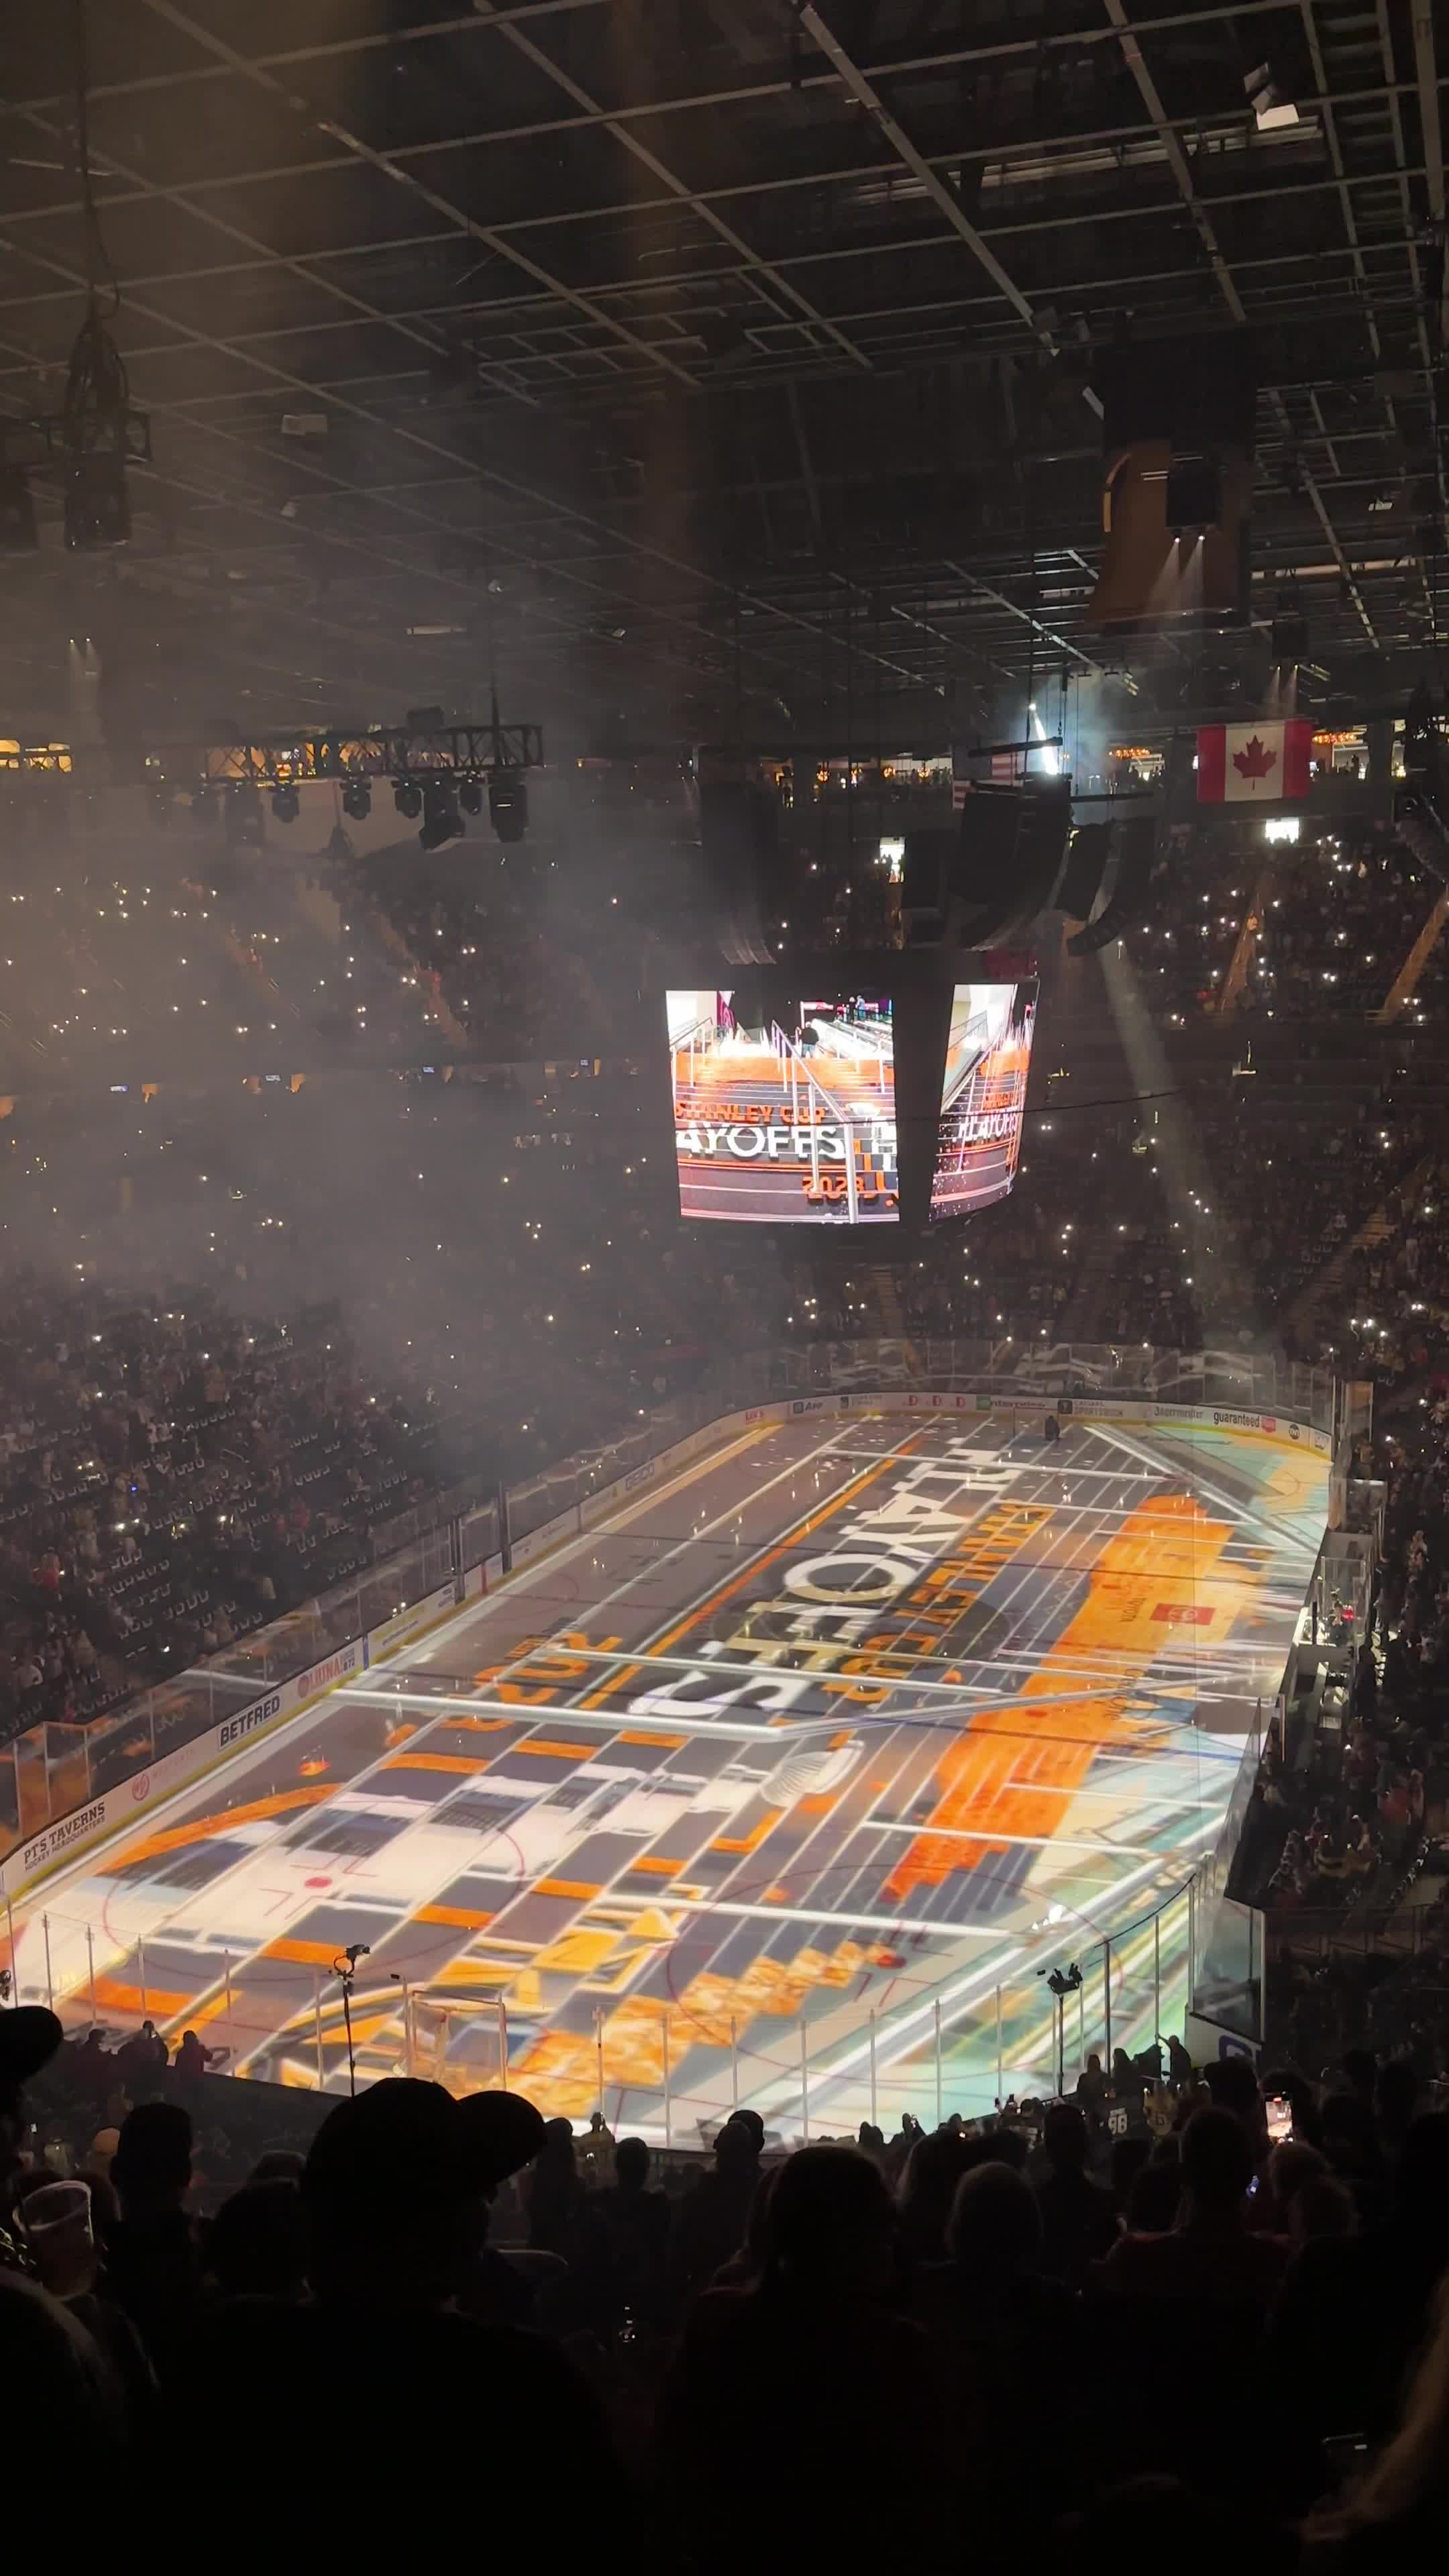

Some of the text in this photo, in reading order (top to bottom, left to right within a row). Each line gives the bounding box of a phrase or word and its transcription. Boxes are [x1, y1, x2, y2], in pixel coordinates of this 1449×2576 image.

[676, 1102, 826, 1126] STANLEY CUP
[1214, 1411, 1260, 1428] guaranteed
[221, 1695, 280, 1747] BETFRED
[49, 1802, 105, 1845] TAVERNS
